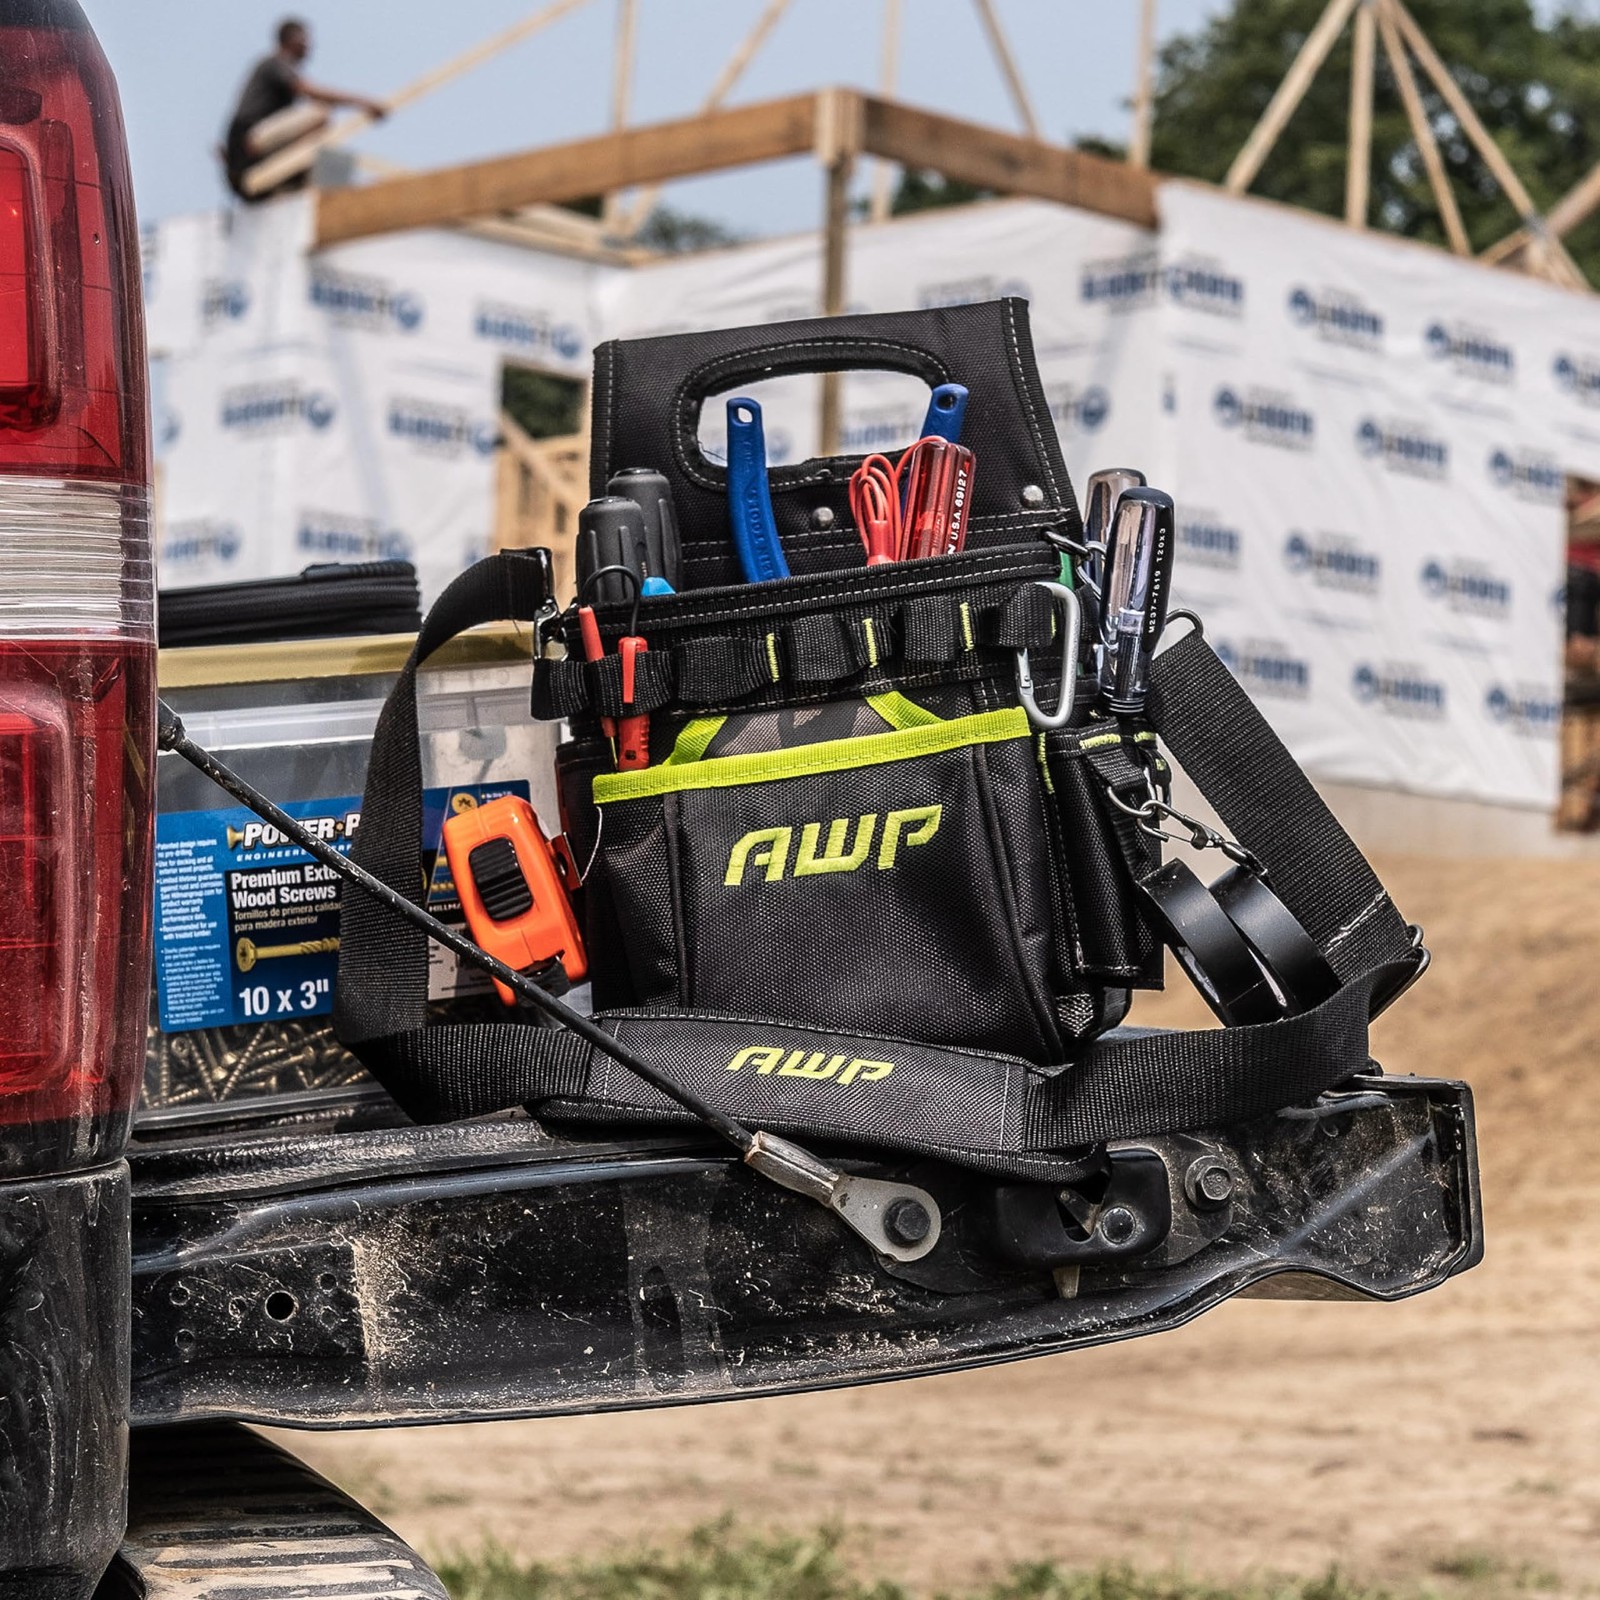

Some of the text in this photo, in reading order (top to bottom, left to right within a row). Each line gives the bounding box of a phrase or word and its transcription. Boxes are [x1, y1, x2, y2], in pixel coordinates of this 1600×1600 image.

[724, 804, 942, 886] AWP
[231, 864, 342, 890] Premium Exte
[232, 886, 336, 909] Wood Screws
[234, 909, 268, 920] Tornillos
[270, 907, 280, 917] de
[282, 904, 313, 916] primera
[235, 915, 318, 934] para madera exterior
[238, 986, 270, 1016] 10
[276, 989, 293, 1013] x
[300, 978, 329, 1010] 3"
[725, 1045, 895, 1086] AWP
